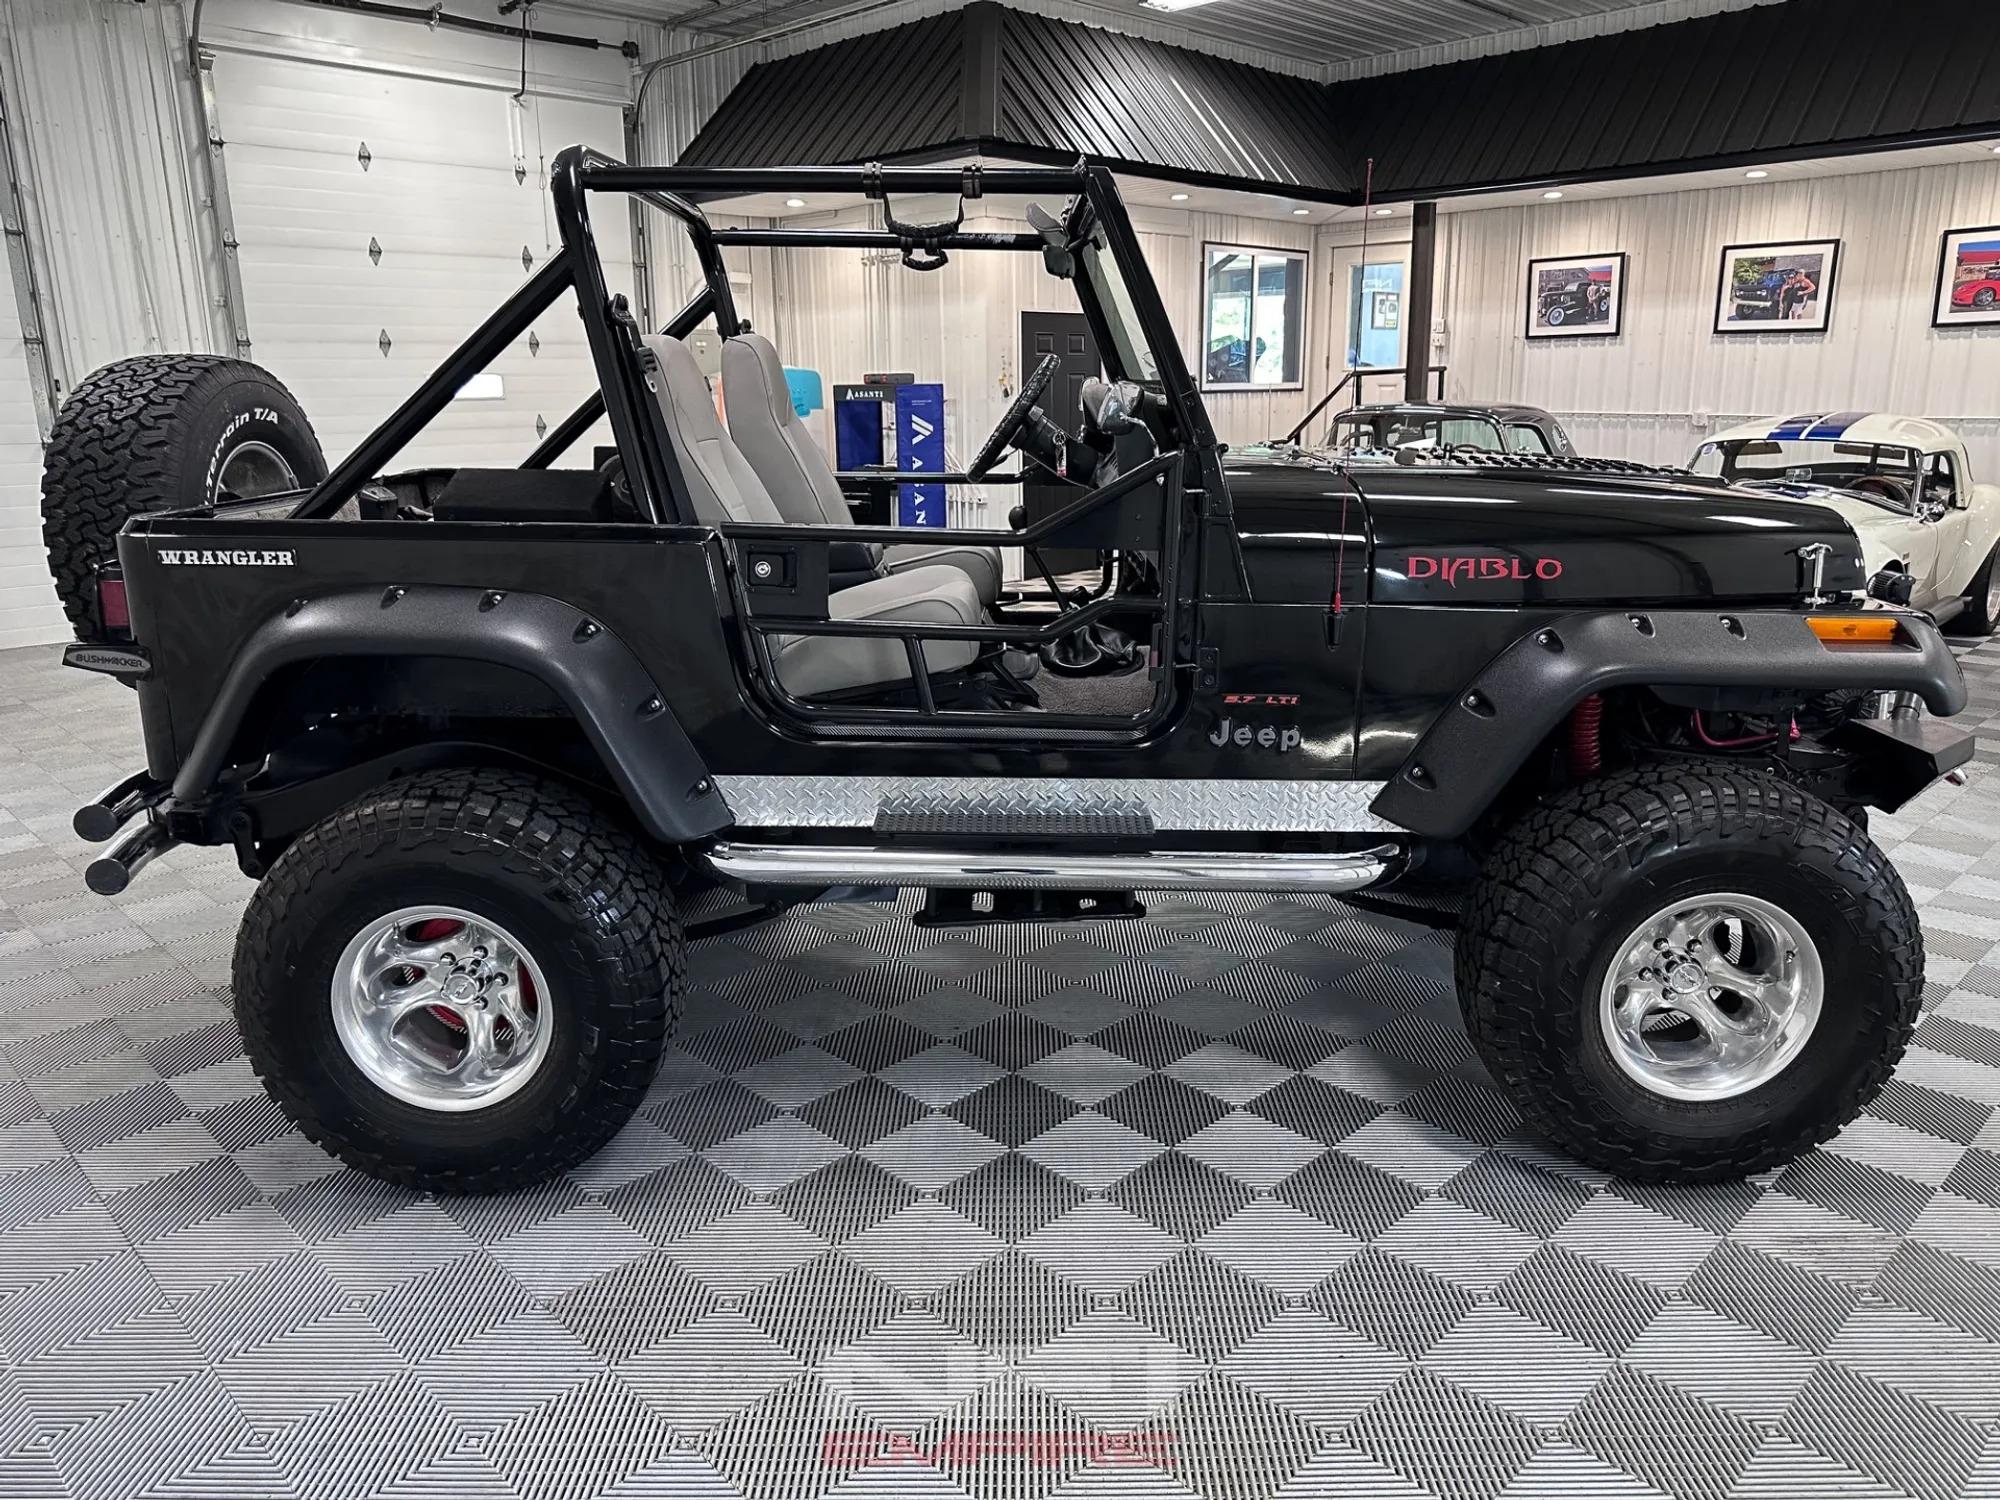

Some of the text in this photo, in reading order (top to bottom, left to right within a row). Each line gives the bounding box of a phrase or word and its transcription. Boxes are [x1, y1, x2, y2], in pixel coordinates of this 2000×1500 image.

[254, 407, 278, 424] T/A
[912, 456, 926, 525] AAN
[158, 550, 294, 566] WRANGLER
[1407, 557, 1563, 588] DIABLO
[76, 654, 144, 668] BUSHWACKER
[1209, 719, 1300, 751] Jeep
